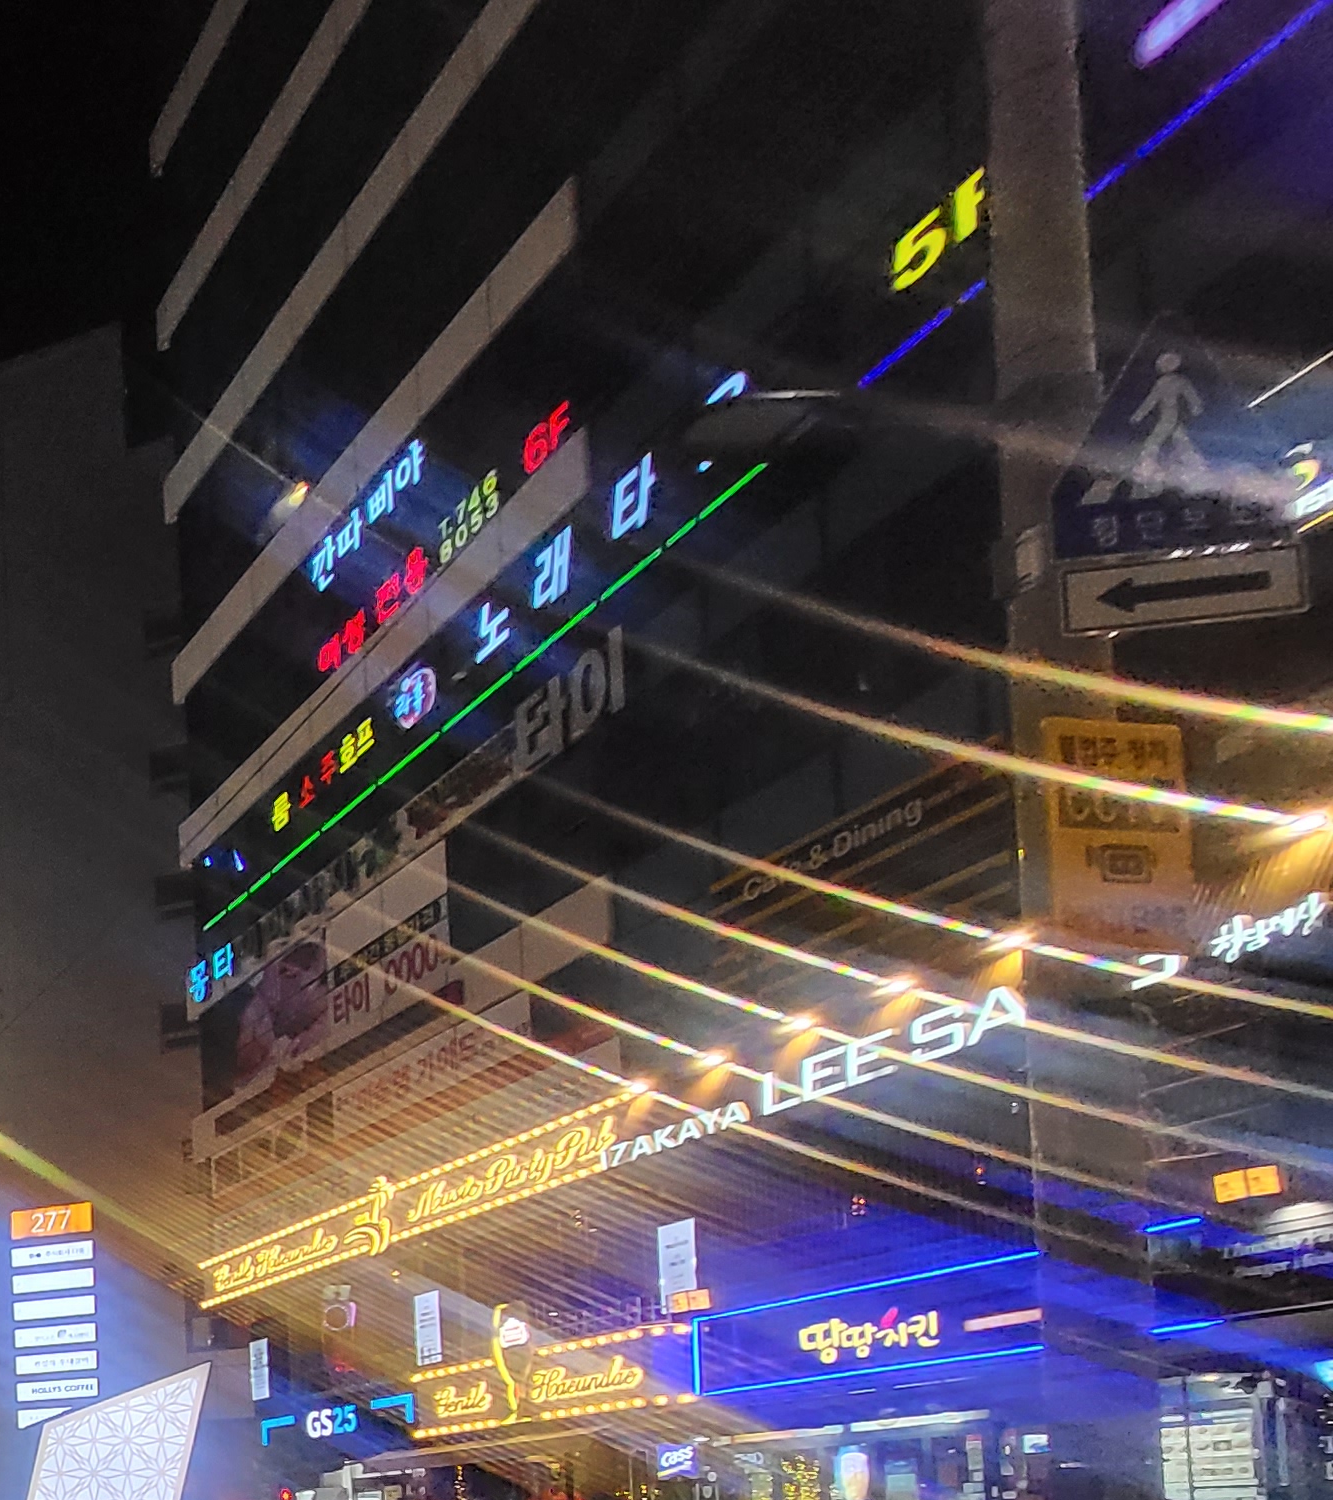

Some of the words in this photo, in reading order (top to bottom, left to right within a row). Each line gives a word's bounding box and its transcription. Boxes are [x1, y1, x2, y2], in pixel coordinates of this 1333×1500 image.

[833, 797, 925, 858] Dining
[600, 1101, 751, 1171] IZAKAYA
[760, 1029, 899, 1116] LEE
[31, 1209, 71, 1233] 277
[306, 1405, 358, 1439] GS25
